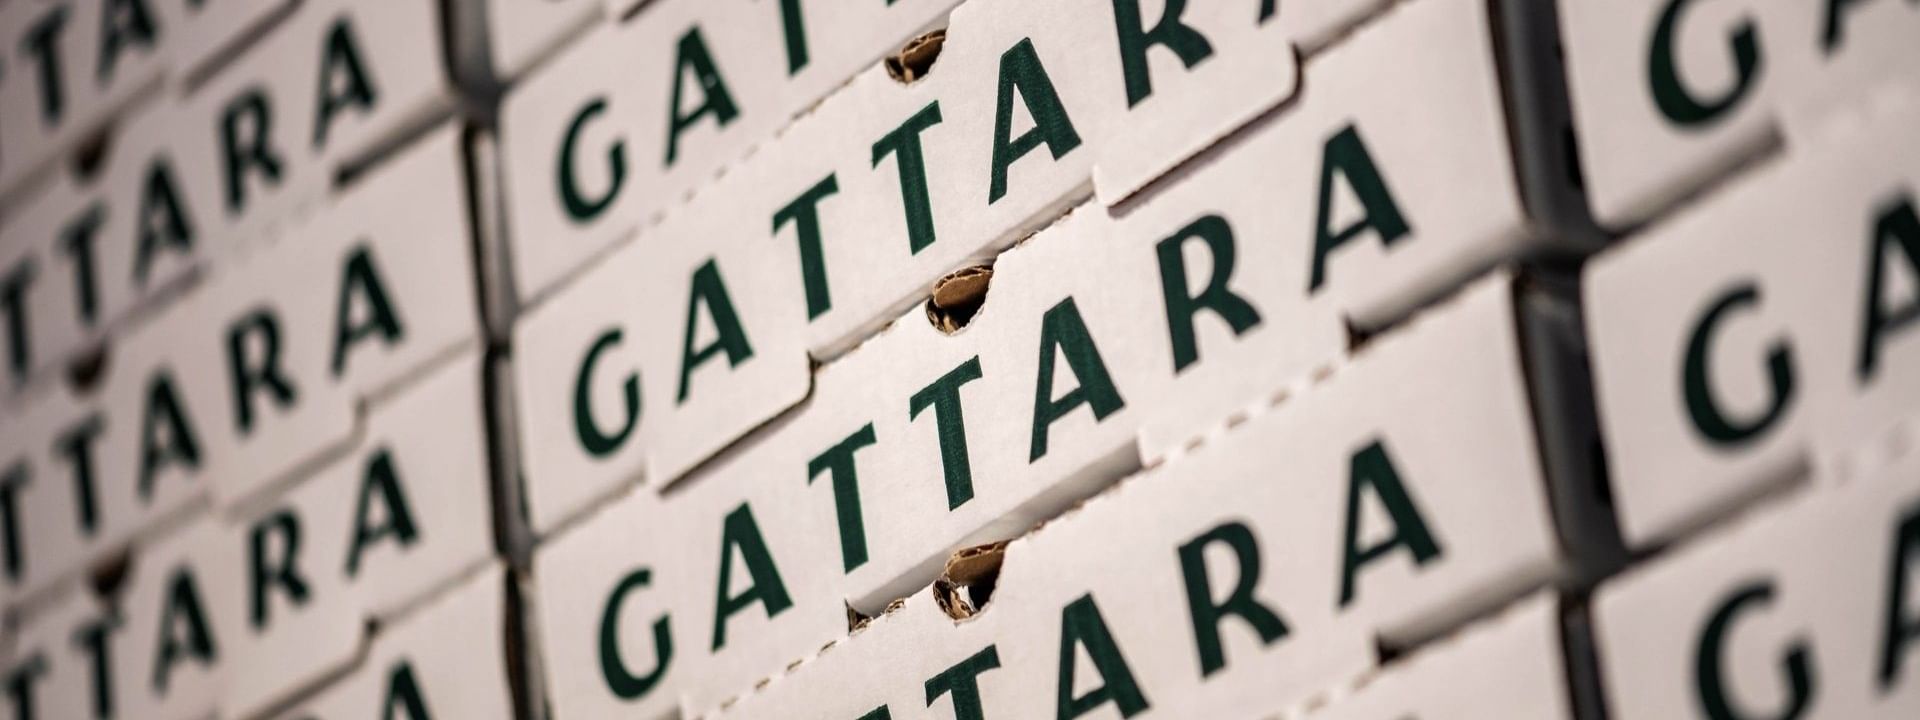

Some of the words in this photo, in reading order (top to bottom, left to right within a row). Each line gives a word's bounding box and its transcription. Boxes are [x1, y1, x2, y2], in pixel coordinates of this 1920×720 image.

[573, 0, 1278, 457] GATTAR
[599, 118, 1413, 699] GATTARA
[857, 433, 1444, 720] TARA
